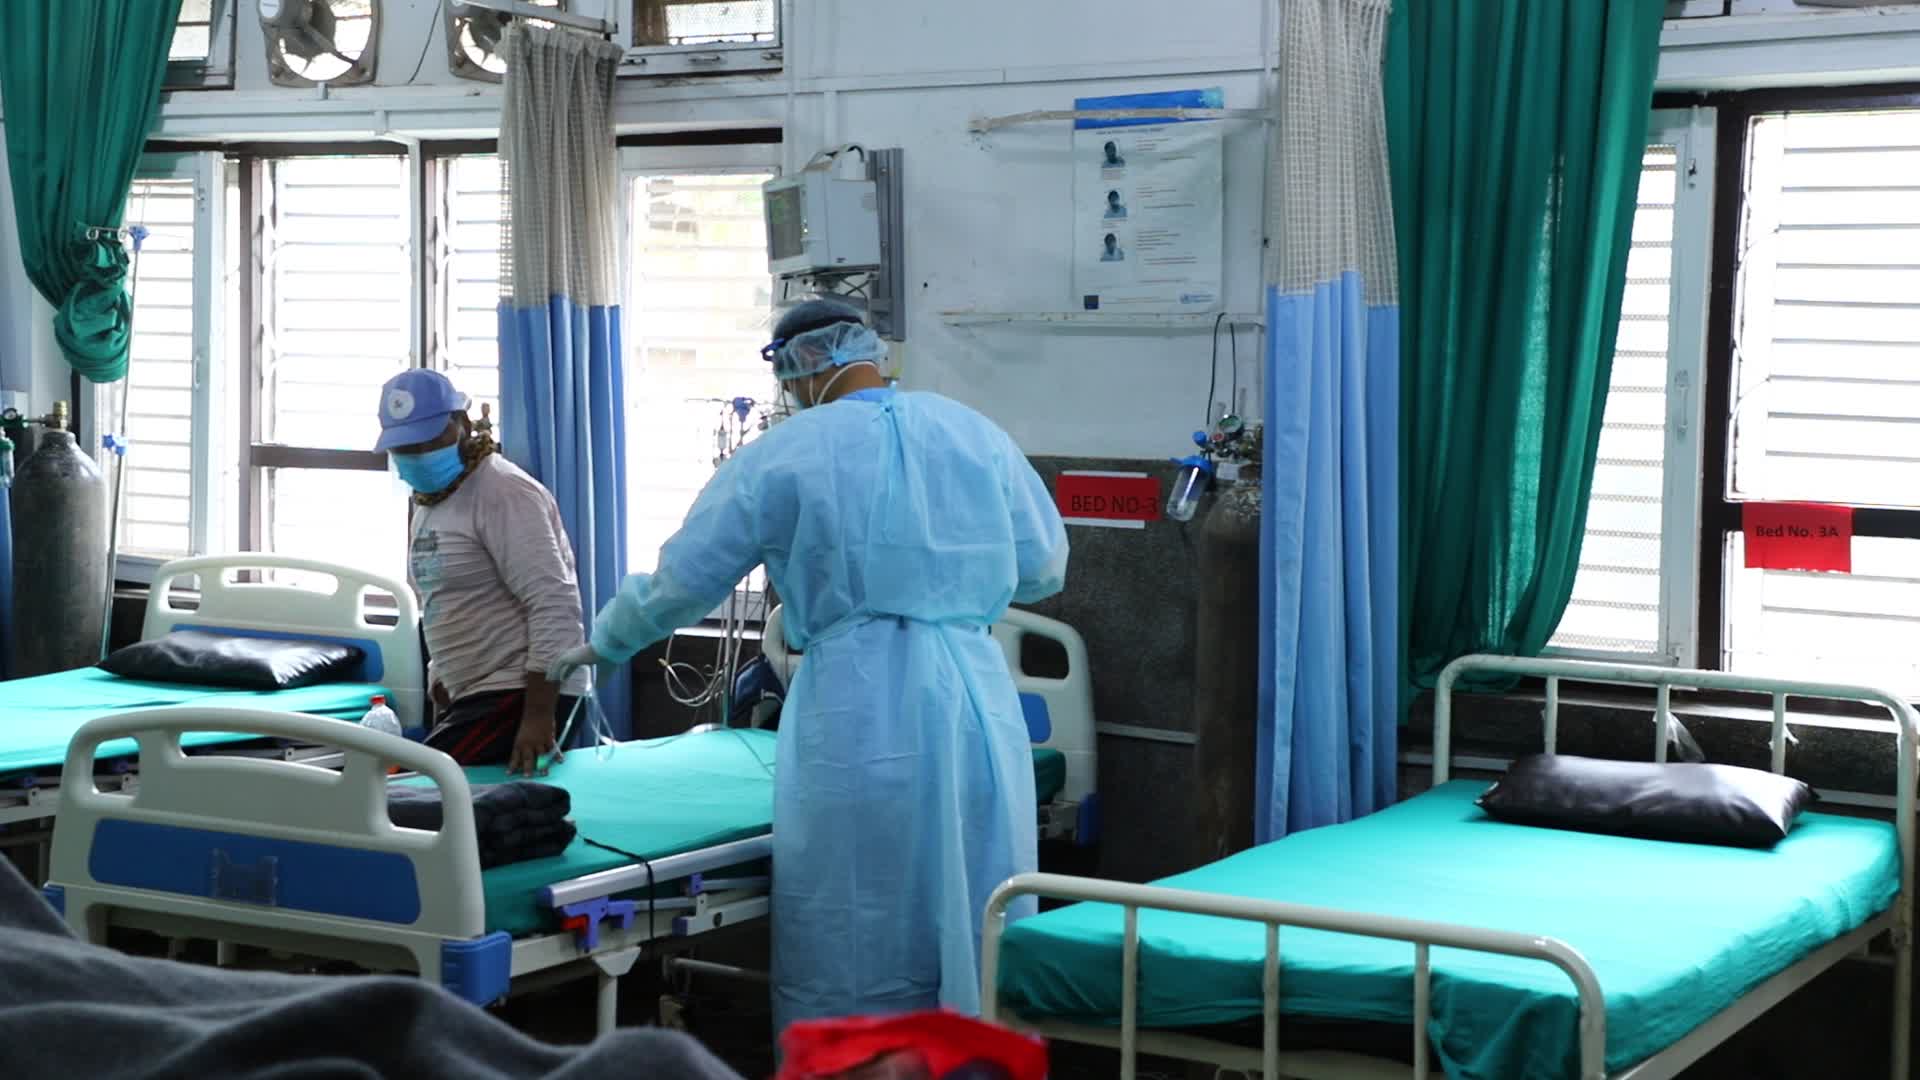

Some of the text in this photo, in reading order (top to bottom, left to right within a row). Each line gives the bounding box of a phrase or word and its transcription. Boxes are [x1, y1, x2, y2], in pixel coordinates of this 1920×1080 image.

[1072, 495, 1106, 512] BED
[1756, 524, 1785, 537] Bed
[1819, 525, 1841, 537] 3A
